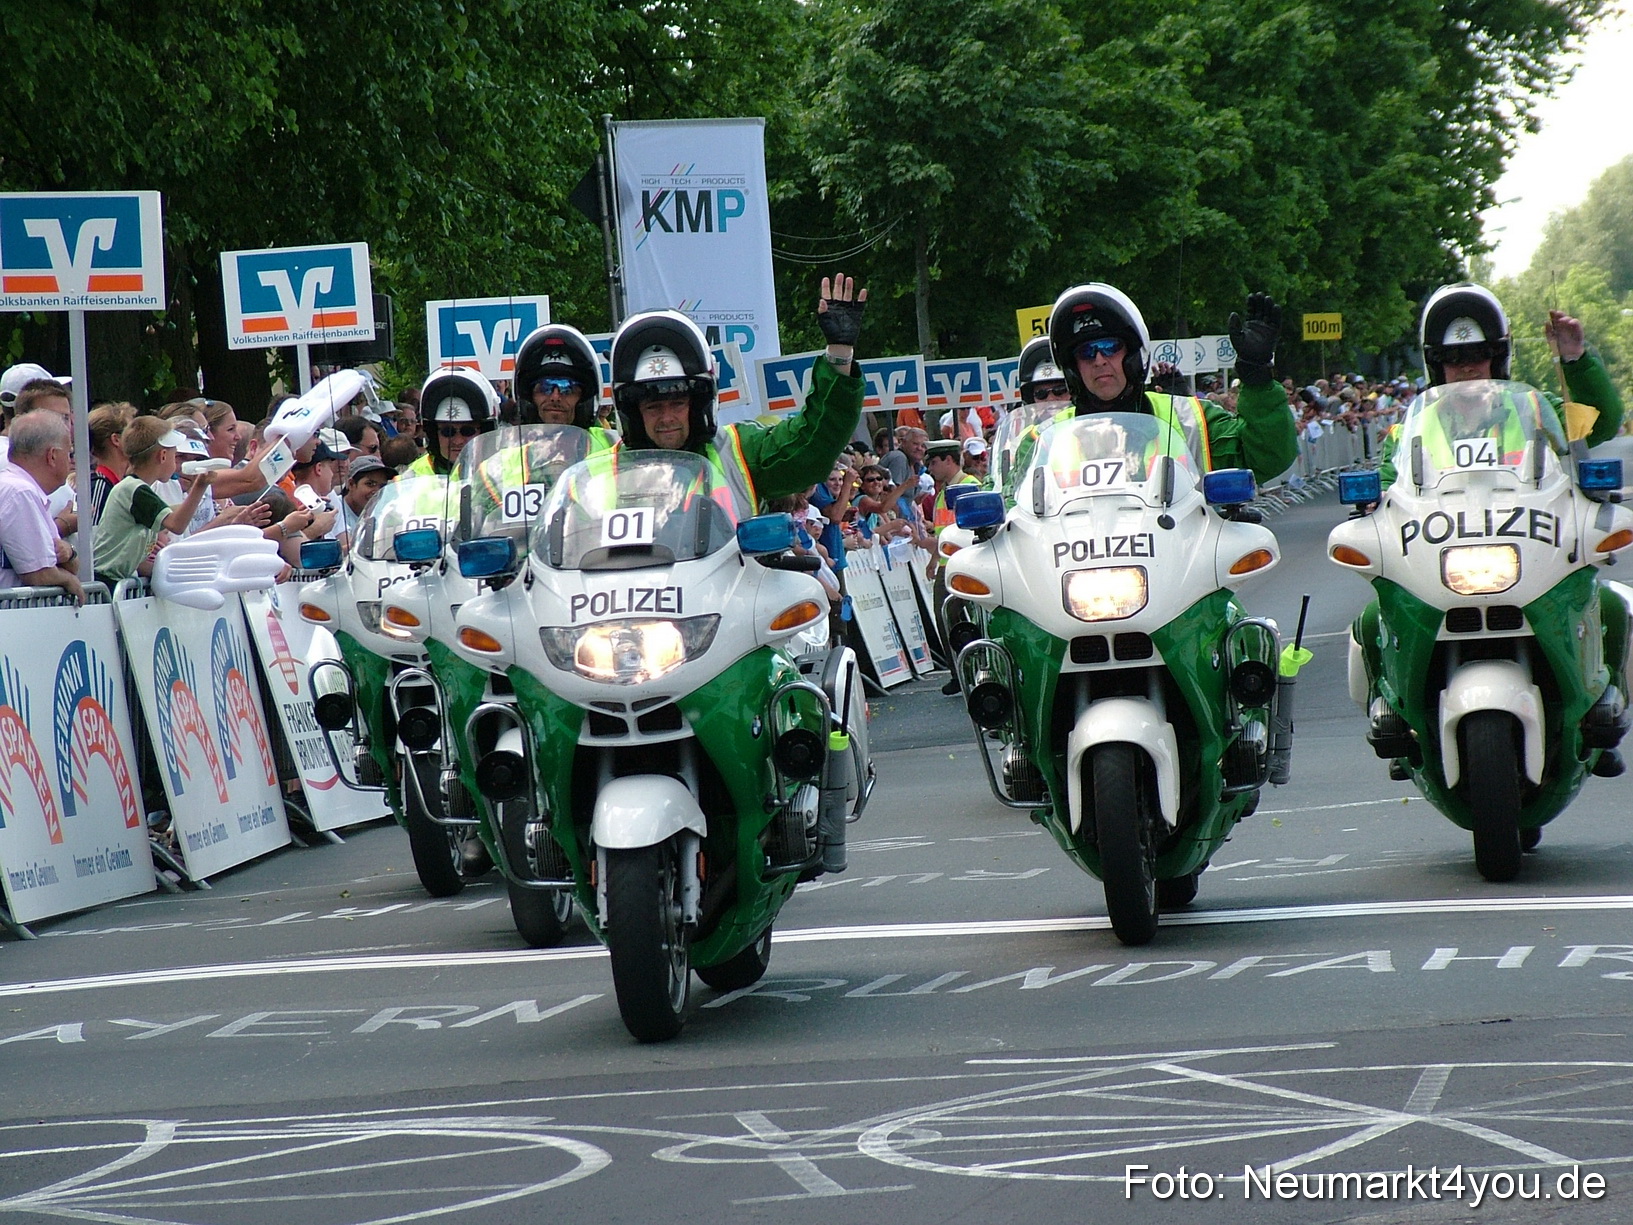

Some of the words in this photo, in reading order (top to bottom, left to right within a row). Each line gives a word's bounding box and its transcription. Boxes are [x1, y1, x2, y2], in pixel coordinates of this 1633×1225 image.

[701, 177, 746, 185] PRODUCTS
[641, 189, 746, 233] KMP
[63, 295, 158, 306] Raiffeisenbanken
[233, 334, 290, 345] Volksbanken
[292, 328, 370, 341] Raiffeisenbanken
[1455, 442, 1497, 468] 04
[1082, 462, 1123, 487] 07
[504, 489, 542, 518] 03
[607, 512, 645, 540] 01
[1400, 507, 1562, 557] POLIZEI
[1053, 533, 1155, 568] POLIZEI
[571, 586, 683, 623] POLIZEI
[56, 651, 84, 794] GEWINN
[283, 701, 320, 734] FRANKE
[82, 707, 135, 823] SPAREN
[295, 737, 332, 770] BRUNNE
[1, 717, 58, 837] SPAREN
[73, 854, 95, 878] Immer
